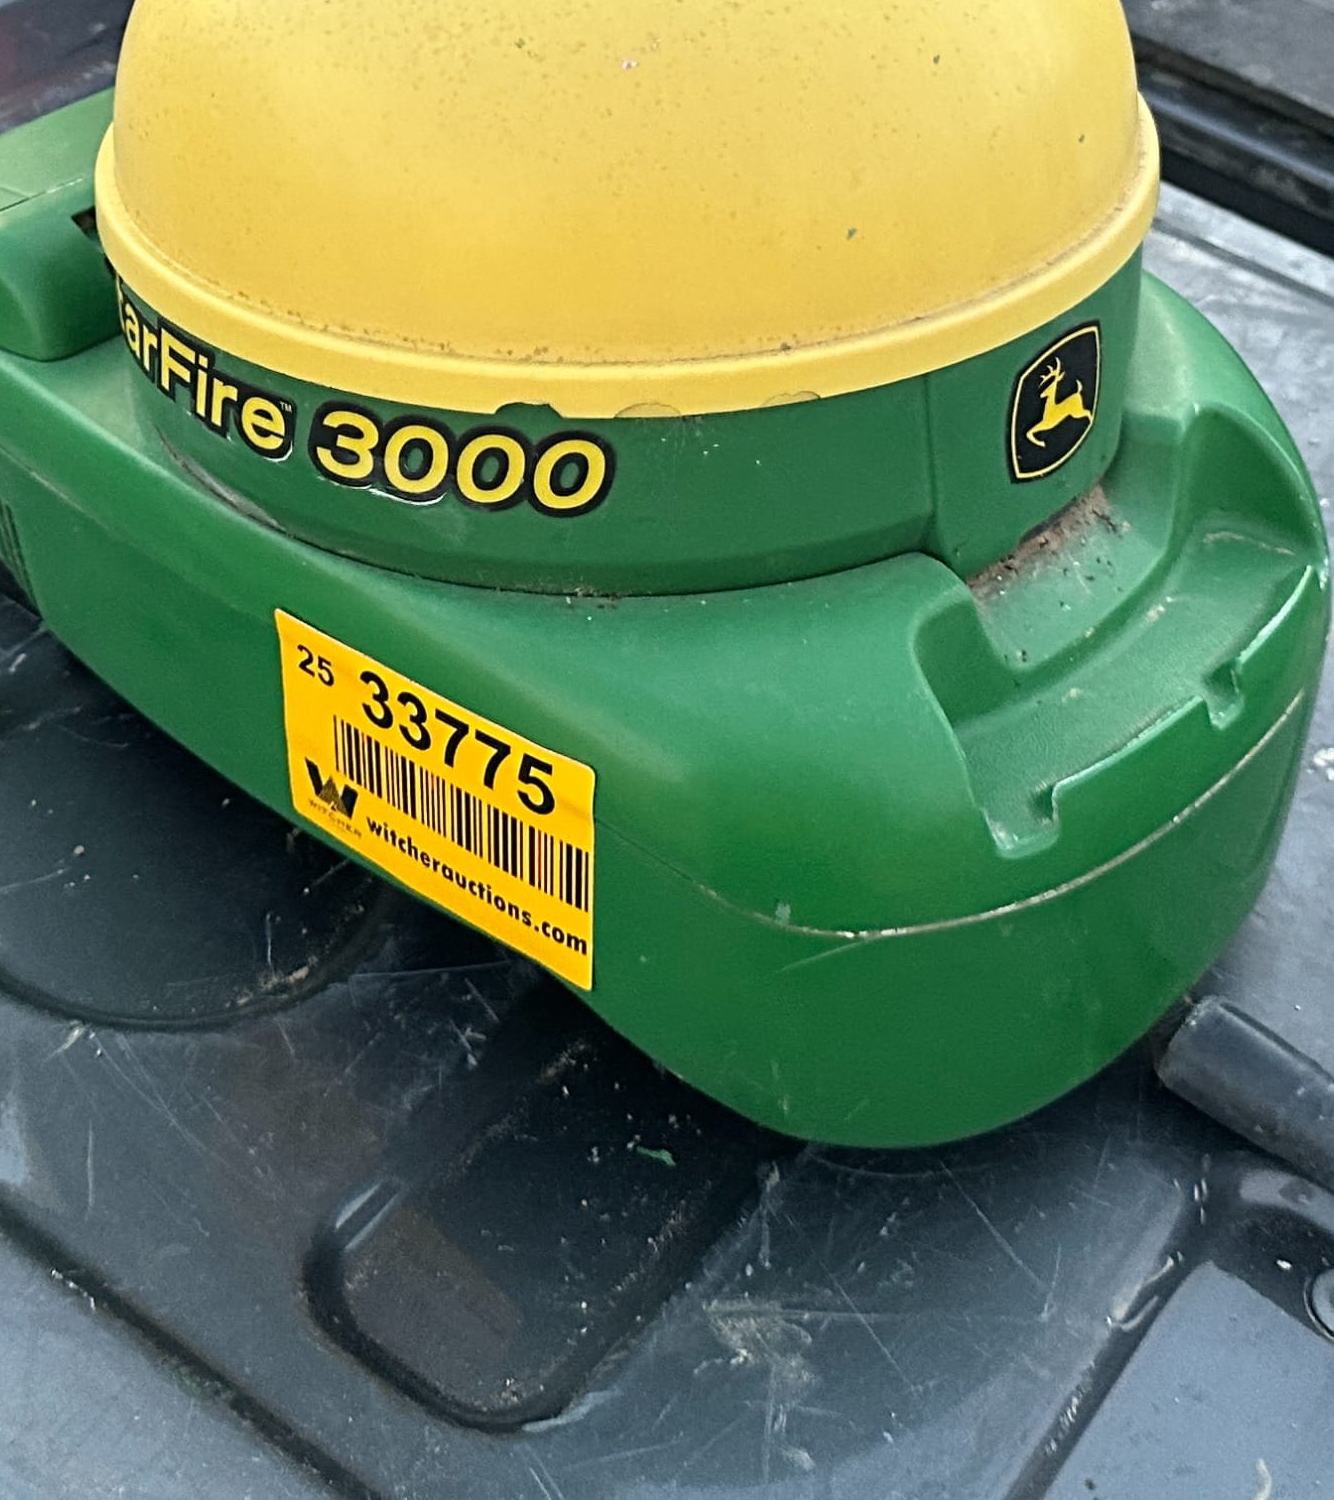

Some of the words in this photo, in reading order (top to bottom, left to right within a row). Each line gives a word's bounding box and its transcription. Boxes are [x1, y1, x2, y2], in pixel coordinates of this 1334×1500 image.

[315, 409, 606, 510] 3000
[296, 643, 335, 688] 25
[359, 670, 556, 816] 33775
[366, 815, 588, 956] witcherauctions.com
